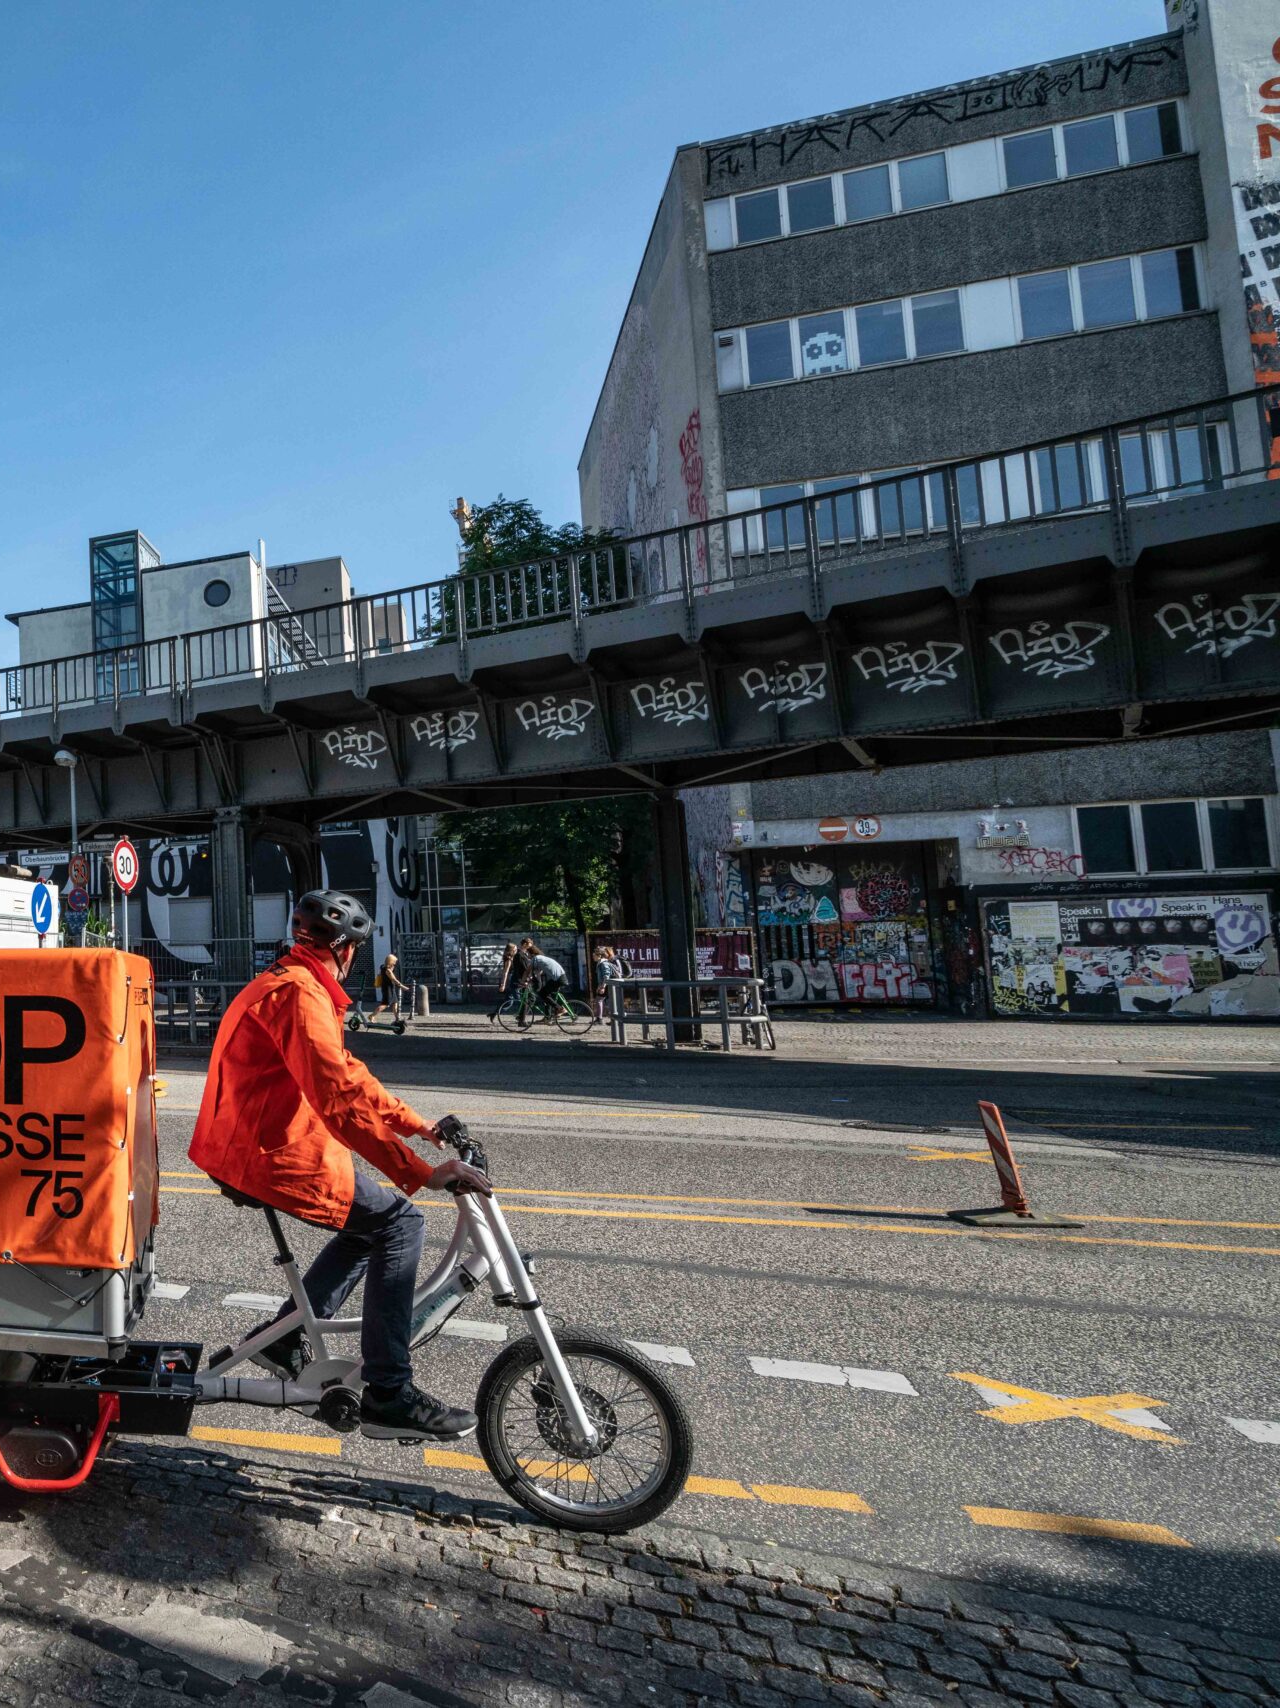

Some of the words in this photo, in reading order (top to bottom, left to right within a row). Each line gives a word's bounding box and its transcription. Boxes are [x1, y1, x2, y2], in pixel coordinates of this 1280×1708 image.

[119, 856, 132, 875] 30
[1212, 896, 1241, 905] Hans
[1059, 907, 1092, 917] Speak
[1092, 906, 1103, 915] in
[1161, 903, 1195, 914] Speak
[1196, 902, 1207, 911] in
[19, 1168, 85, 1222] 75
